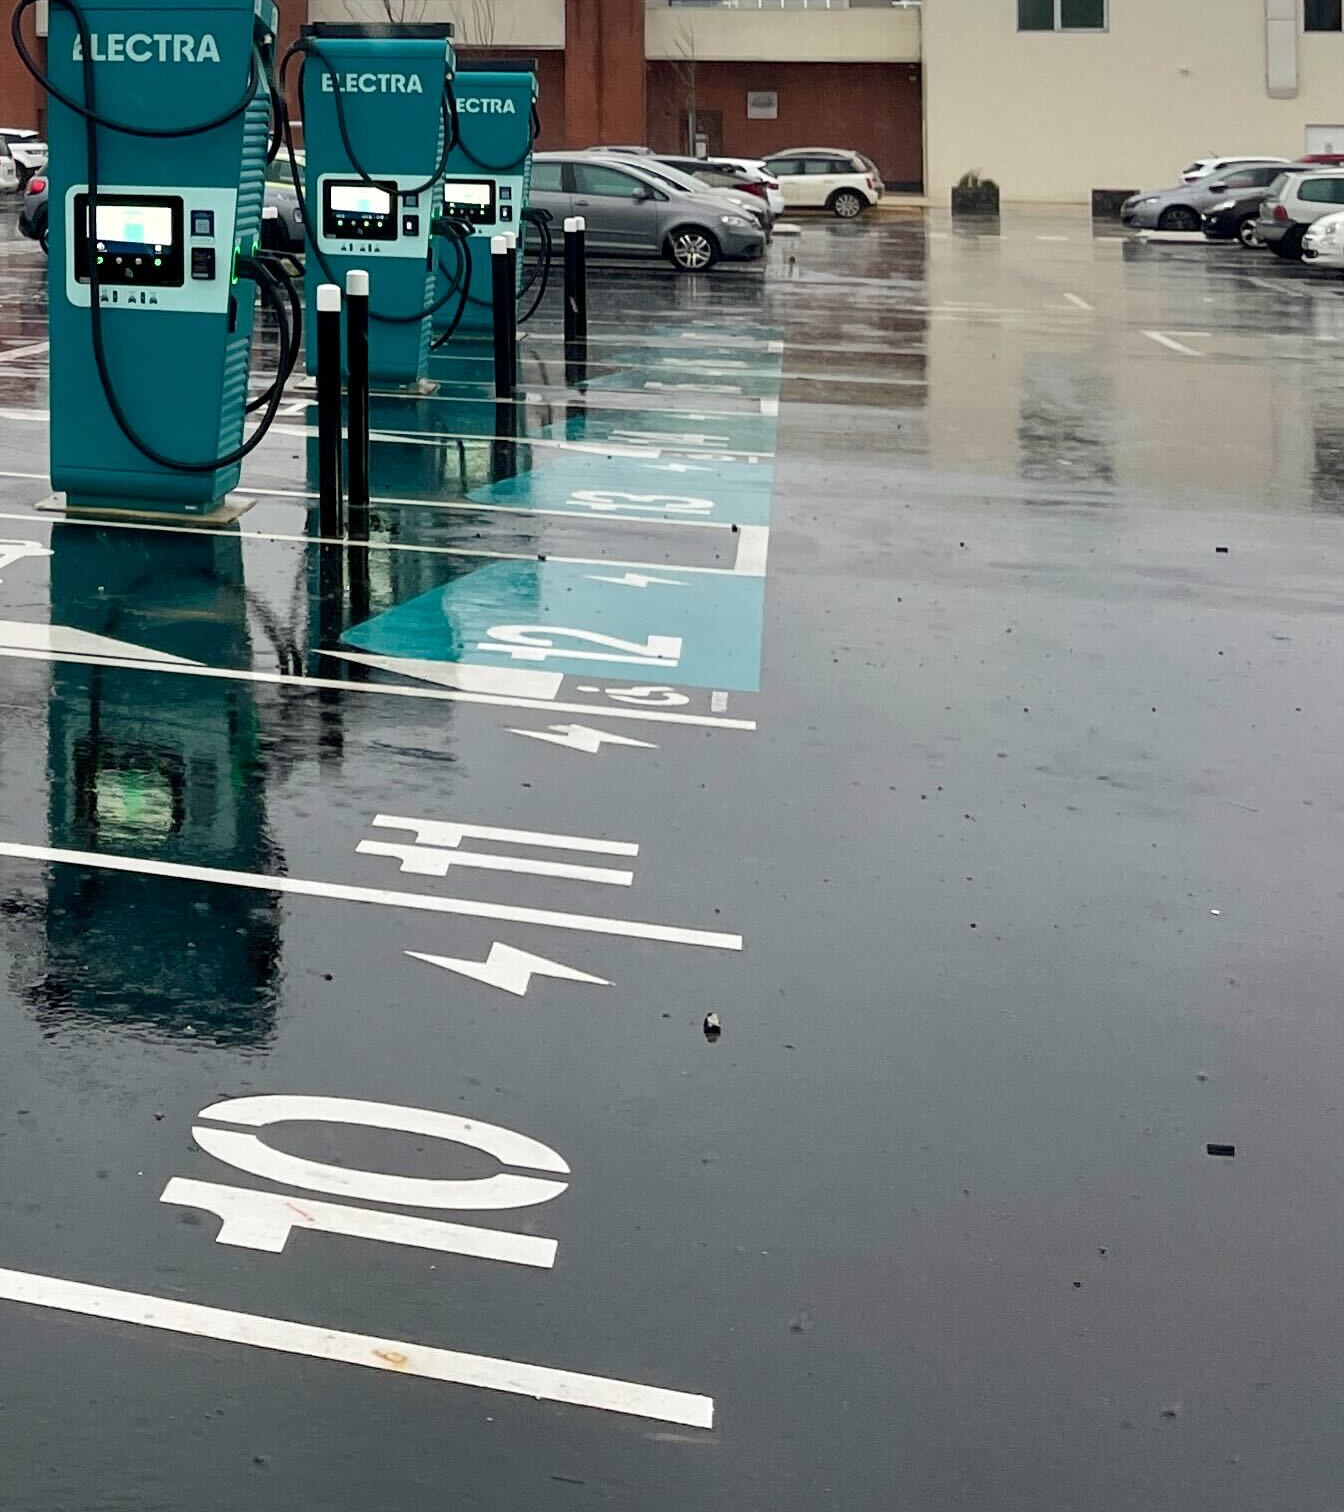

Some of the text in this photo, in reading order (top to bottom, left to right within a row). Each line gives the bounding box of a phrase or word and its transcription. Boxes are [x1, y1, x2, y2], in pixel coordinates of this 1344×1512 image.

[456, 98, 515, 114] ECTRA
[565, 489, 715, 516] 13
[477, 624, 683, 668] 12
[355, 813, 640, 887] 11
[159, 1094, 572, 1269] 10
